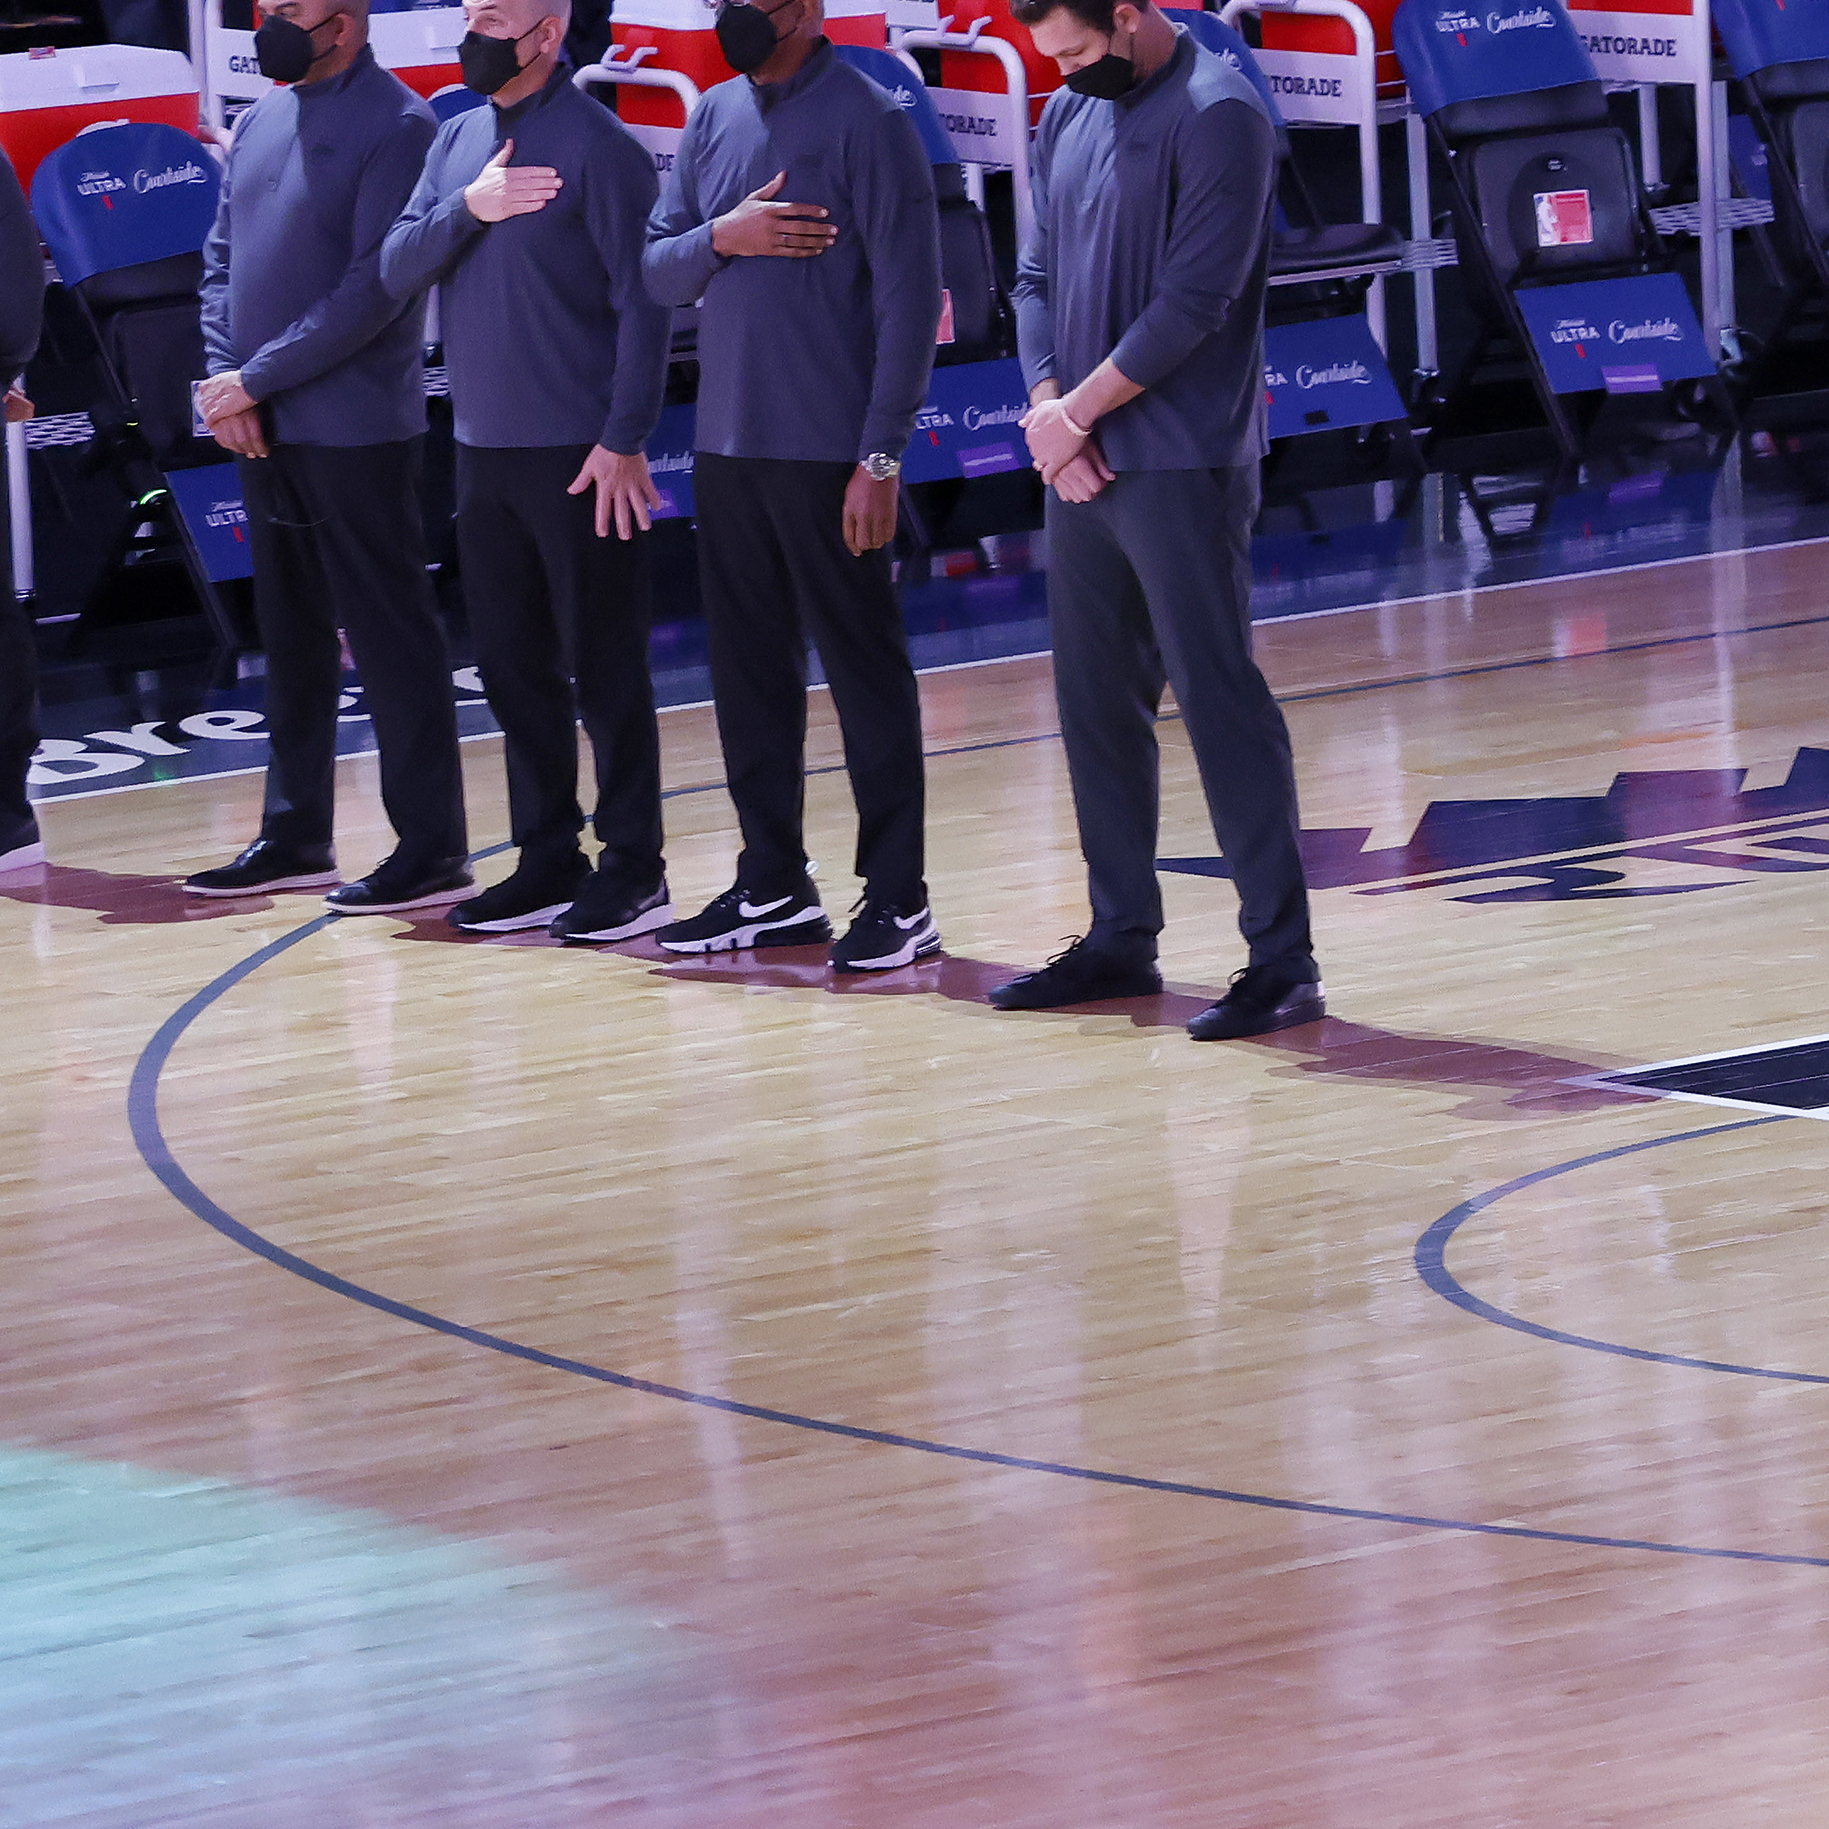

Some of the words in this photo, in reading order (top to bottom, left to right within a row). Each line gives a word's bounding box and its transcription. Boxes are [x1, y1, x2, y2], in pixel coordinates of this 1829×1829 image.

[1270, 75, 1343, 98] TORADE
[937, 112, 998, 137] ORADE
[77, 177, 128, 196] ULTRA
[915, 412, 954, 431] LTRA
[204, 508, 249, 527] ULTR
[27, 710, 271, 786] Bre
